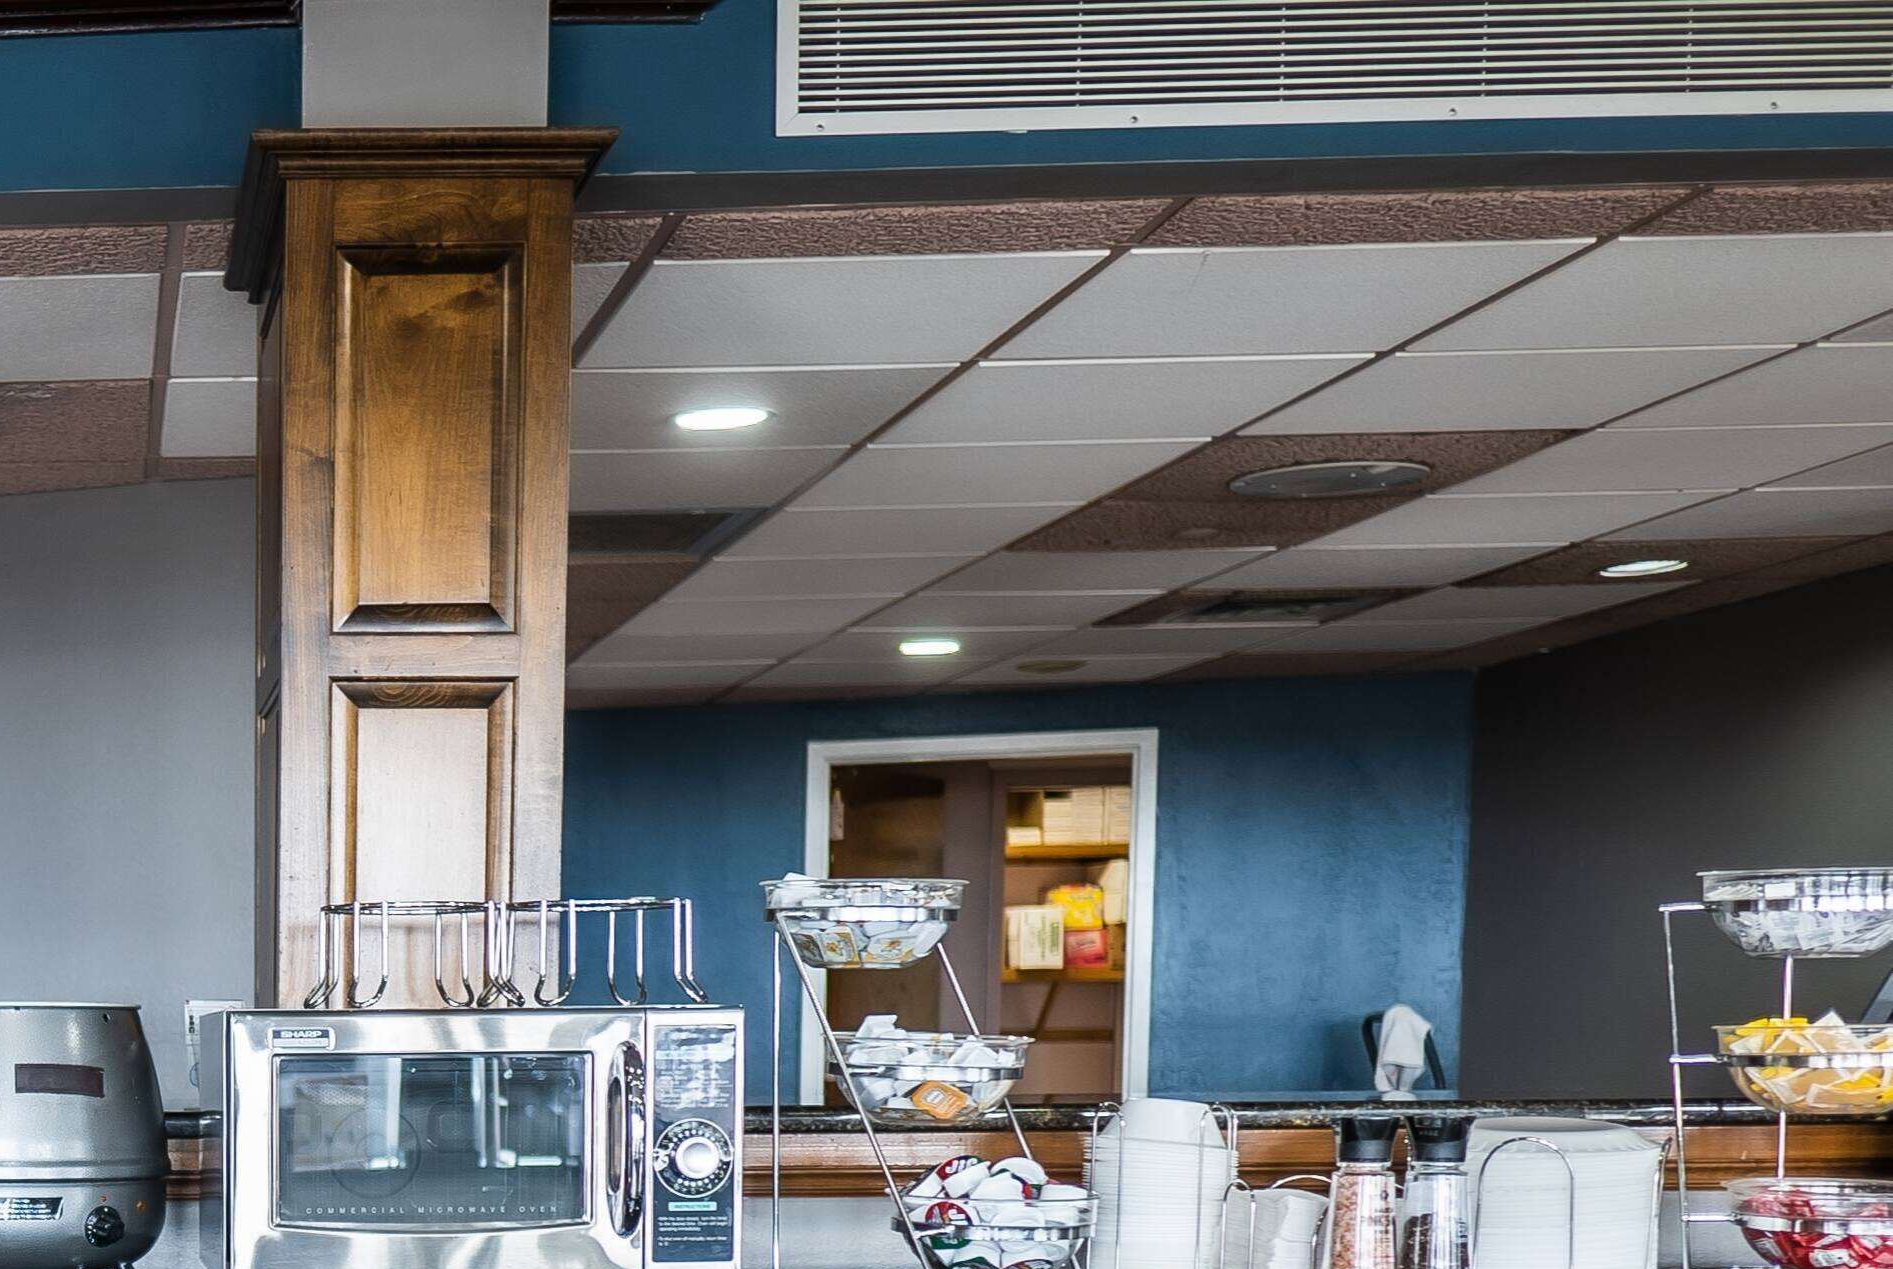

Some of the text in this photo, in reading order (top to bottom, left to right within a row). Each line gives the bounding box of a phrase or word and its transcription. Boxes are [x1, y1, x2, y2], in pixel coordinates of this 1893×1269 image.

[280, 1030, 322, 1038] SHARP
[305, 1206, 557, 1215] COMMERCIAL MICROWAVE OVEN
